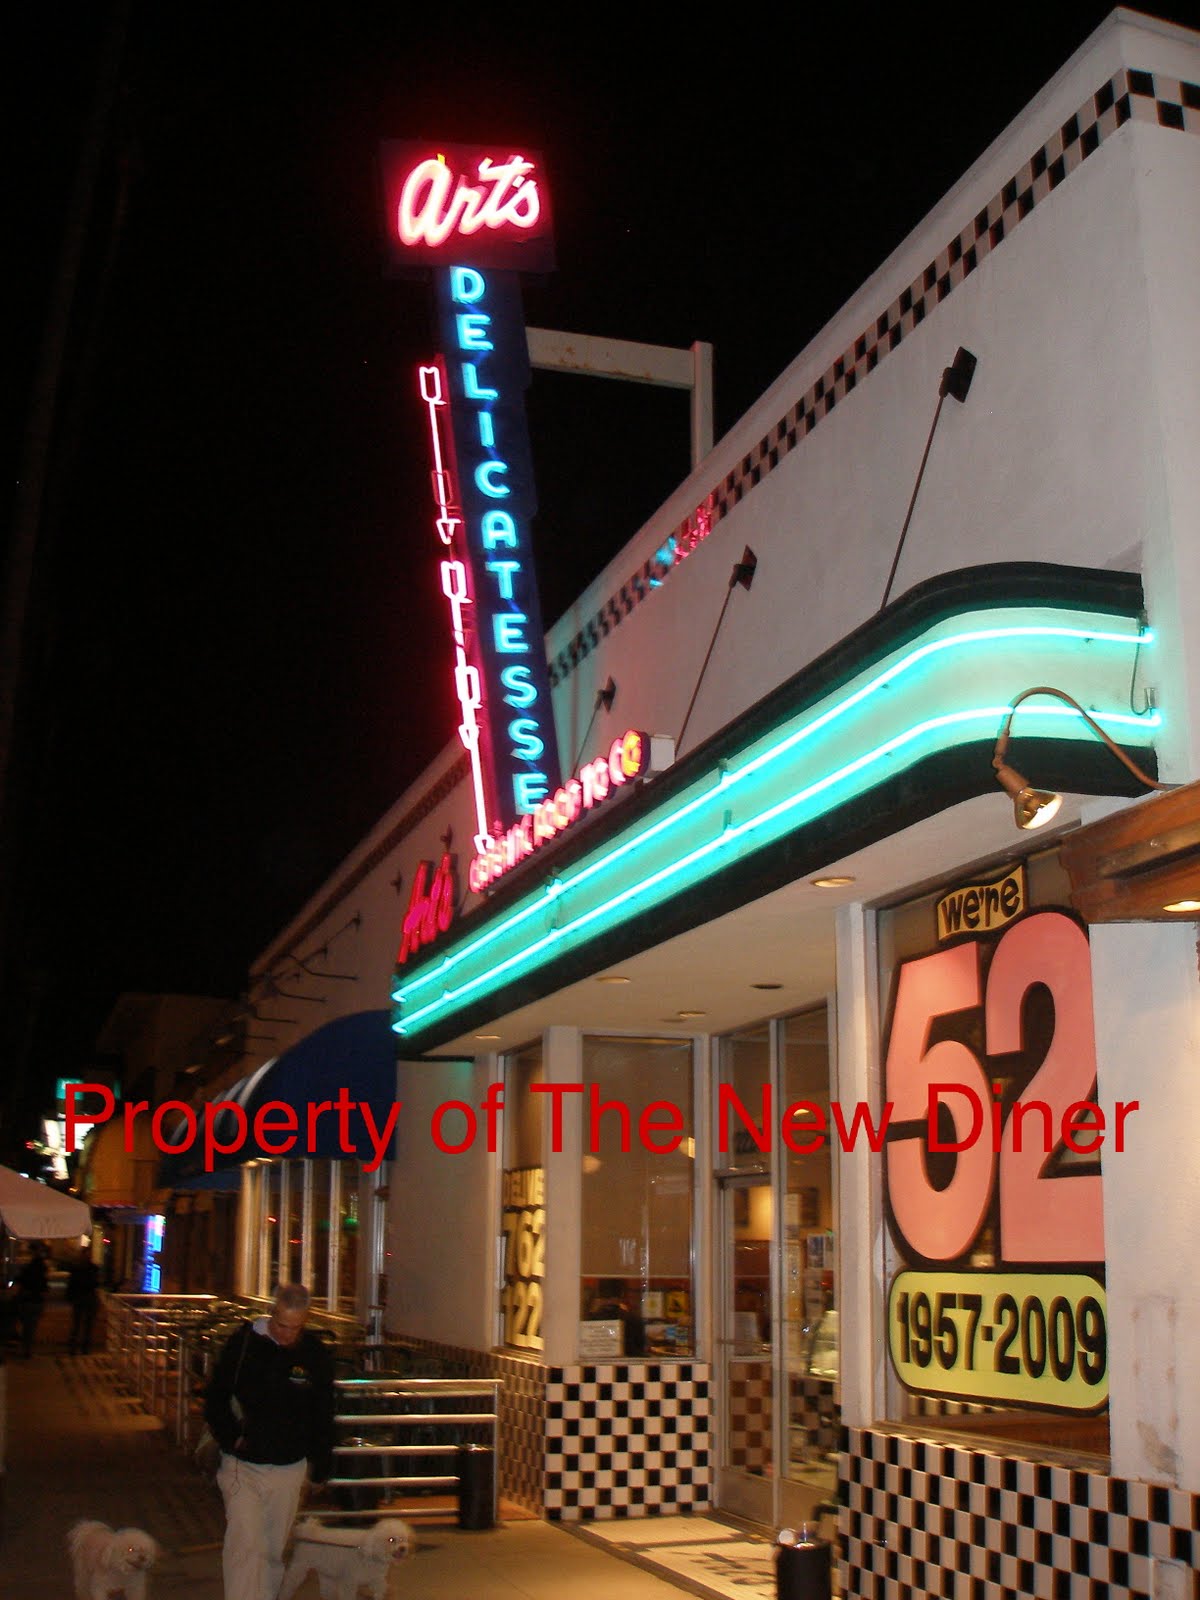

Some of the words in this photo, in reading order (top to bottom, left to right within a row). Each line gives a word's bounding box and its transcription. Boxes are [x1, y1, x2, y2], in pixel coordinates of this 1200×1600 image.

[398, 154, 541, 247] Art's
[451, 265, 553, 815] DELICATESSE
[941, 877, 1020, 934] we're
[886, 911, 1106, 1263] 52
[897, 1291, 1107, 1386] 1957-2009
